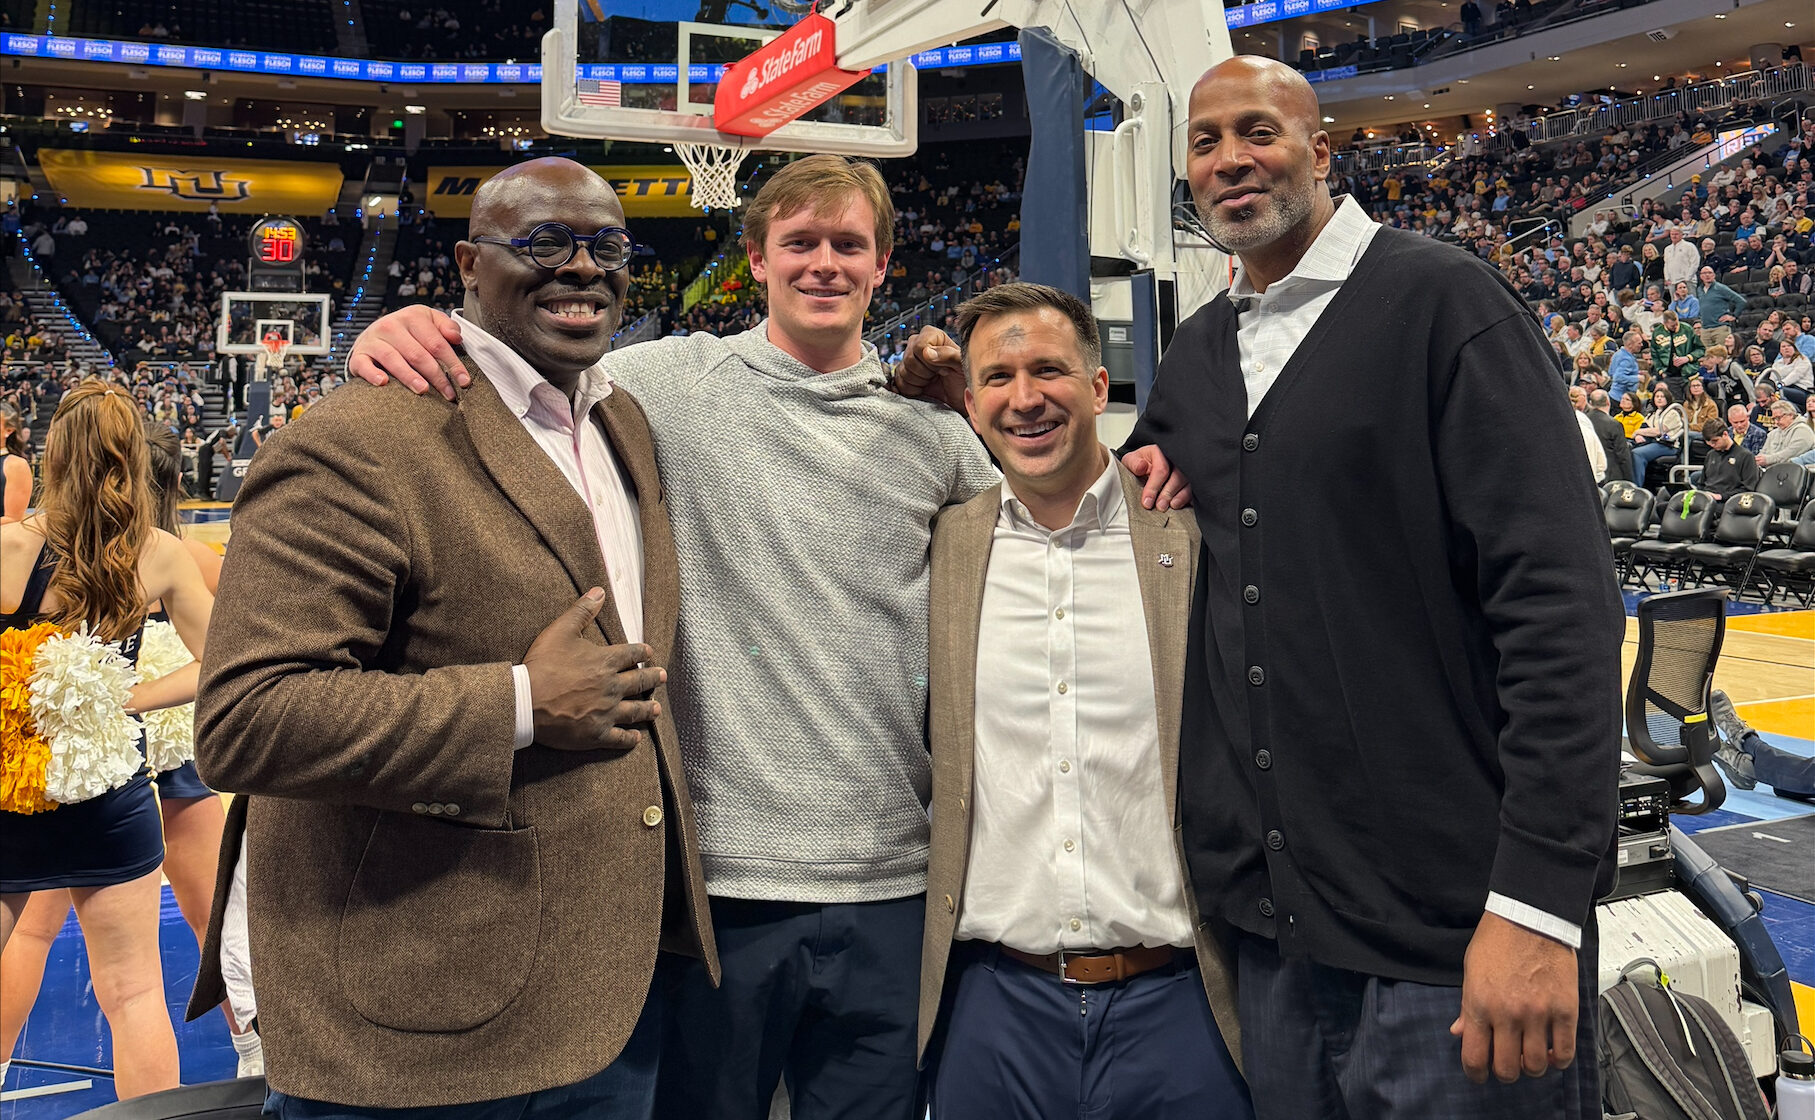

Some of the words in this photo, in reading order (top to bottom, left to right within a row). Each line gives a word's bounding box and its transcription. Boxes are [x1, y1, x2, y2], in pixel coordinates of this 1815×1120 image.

[1252, 7, 1276, 16] FLESCH
[1284, 1, 1309, 11] FLESCH
[1649, 31, 1667, 42] 116
[948, 52, 971, 60] FLESCH
[979, 49, 1001, 57] FLESCH
[138, 166, 253, 202] MU
[433, 177, 481, 195] M
[264, 227, 297, 240] 14:53
[262, 239, 294, 261] 30
[1158, 553, 1174, 566] MU
